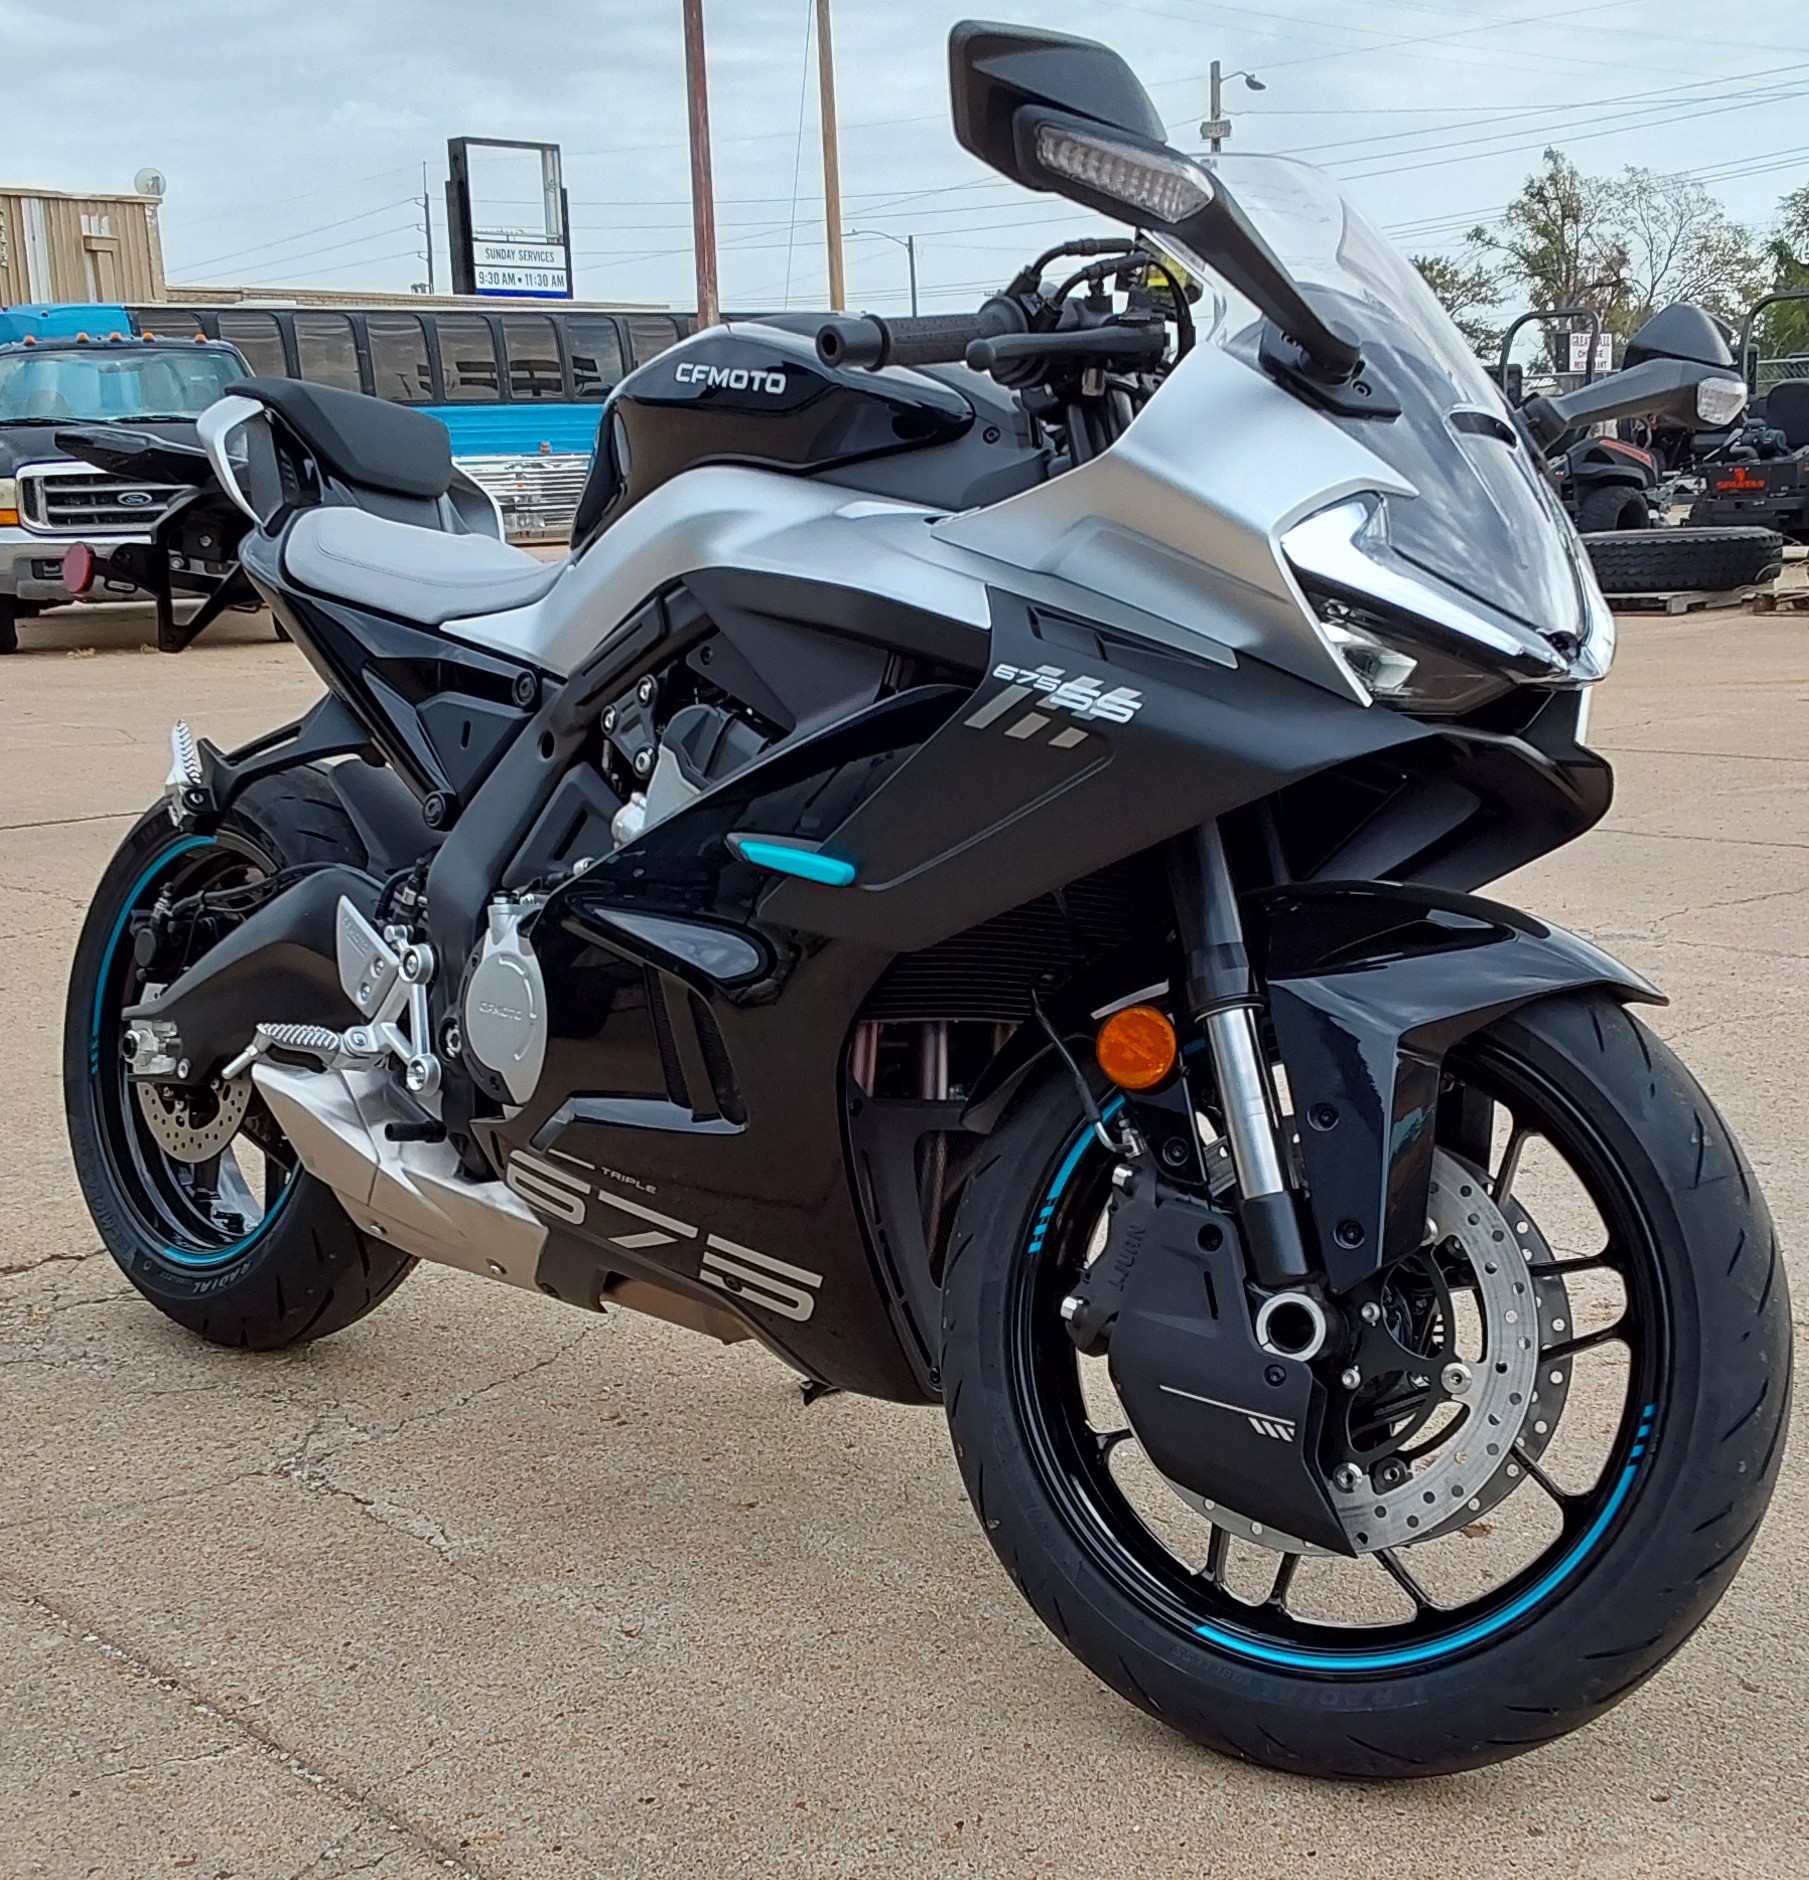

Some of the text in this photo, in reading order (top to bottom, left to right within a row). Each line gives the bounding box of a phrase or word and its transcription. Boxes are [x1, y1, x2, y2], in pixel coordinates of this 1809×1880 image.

[485, 247, 555, 263] SUNDAY SERVICES
[478, 271, 565, 287] 9:30 AM 11:30 AM
[675, 362, 787, 396] CFMOTO
[600, 1166, 657, 1195] TRIPLE
[506, 1150, 824, 1322] 675
[192, 1260, 252, 1293] RADIAL
